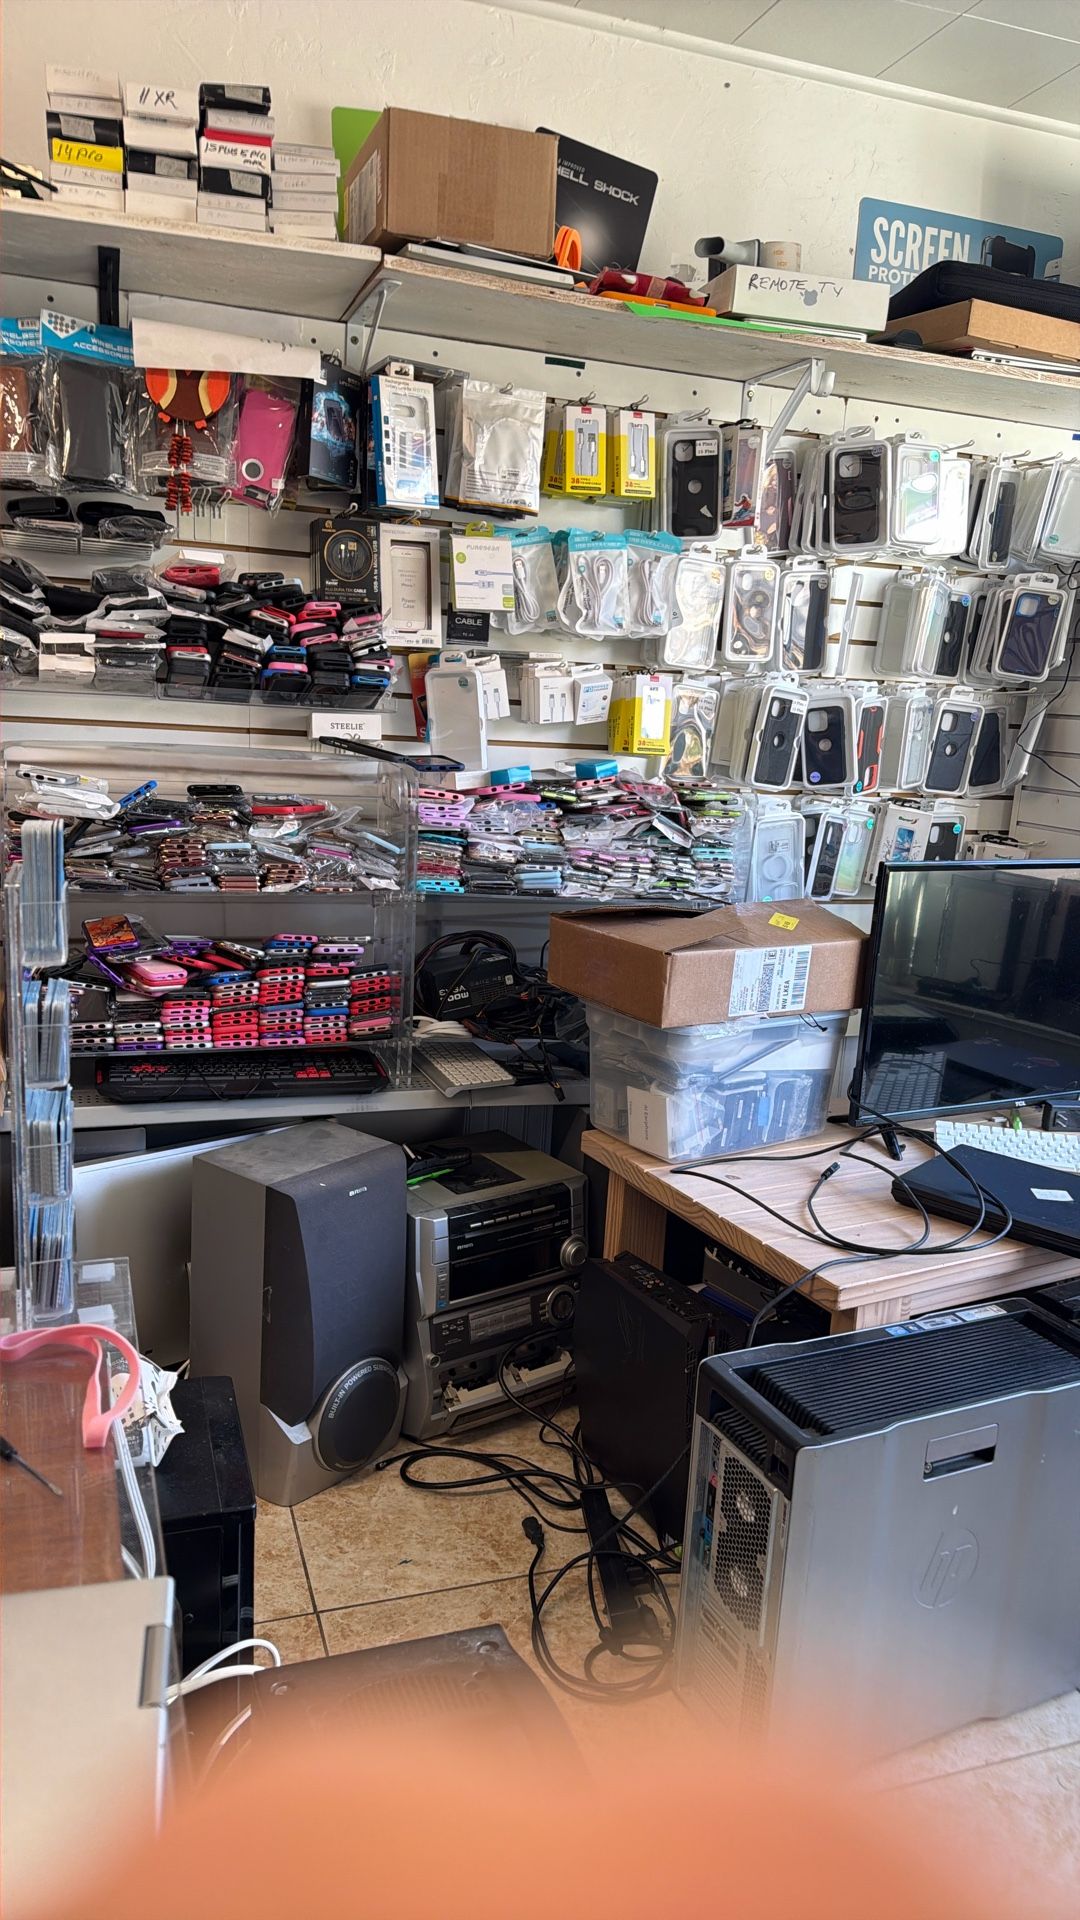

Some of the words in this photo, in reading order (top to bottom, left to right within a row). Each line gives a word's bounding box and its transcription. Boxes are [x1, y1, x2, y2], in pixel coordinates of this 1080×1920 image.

[139, 87, 150, 105] 11
[154, 90, 178, 110] XR
[57, 144, 73, 160] 14
[593, 179, 640, 206] SHOCK
[870, 216, 971, 271] SCREEN
[748, 273, 808, 293] REMOTE
[455, 617, 483, 626] CABLE
[330, 722, 364, 730] STEELIE
[438, 985, 467, 996] EGA
[439, 991, 470, 1002] 00W
[328, 1389, 346, 1419] BUILT-IN
[344, 1366, 372, 1390] POWERED
